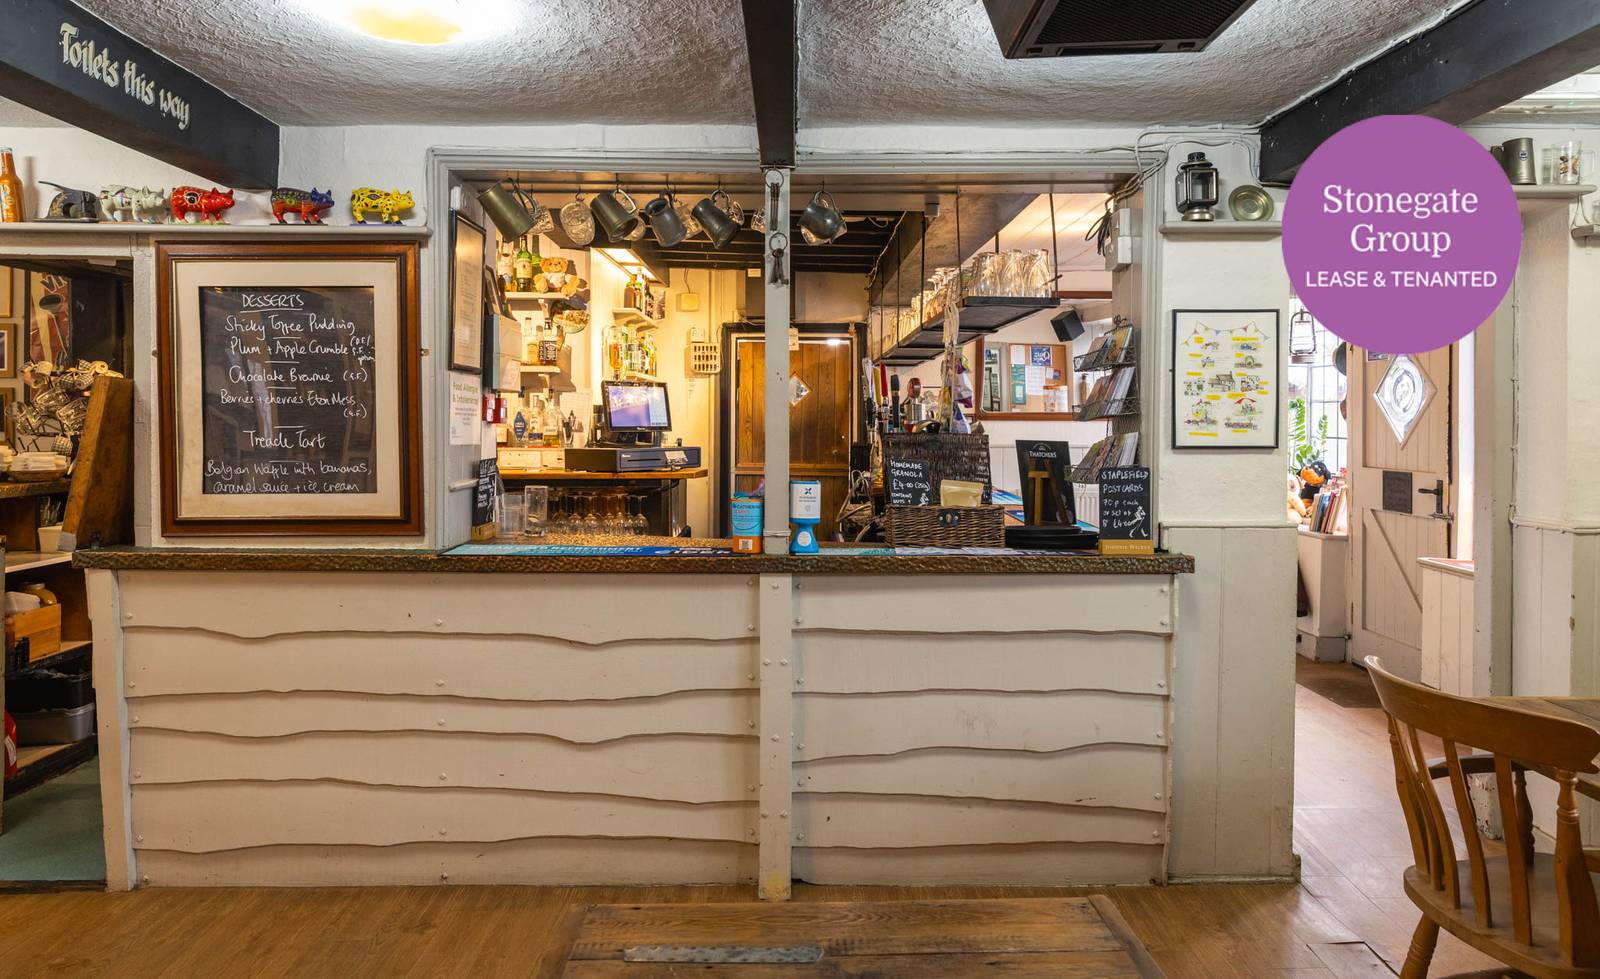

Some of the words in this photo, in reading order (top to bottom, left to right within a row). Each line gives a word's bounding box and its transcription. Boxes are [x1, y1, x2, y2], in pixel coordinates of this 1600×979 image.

[59, 22, 119, 88] Toilets
[123, 60, 155, 106] this
[159, 88, 190, 131] way
[242, 294, 305, 308] DESSERTS
[224, 315, 266, 340] Sticky
[268, 314, 304, 335] Toffee
[308, 313, 356, 336] Pudding
[230, 336, 261, 355] Plum
[268, 345, 273, 355] +
[275, 340, 307, 359] Apple
[308, 340, 349, 355] Crumble
[229, 365, 285, 384] Chocolate
[290, 368, 334, 382] Brownie
[220, 389, 255, 405] Berries
[264, 391, 304, 405] cherries
[307, 390, 331, 407] Eton
[332, 392, 356, 406] Mess
[243, 430, 294, 449] Treacle
[296, 429, 326, 449] Tart
[205, 460, 250, 480] Belgian
[254, 463, 290, 479] Waffle
[294, 463, 315, 476] with
[890, 460, 922, 470] HOMEMADE
[891, 469, 923, 478] GRANOLA
[1101, 469, 1149, 480] STAPLEFIELD
[302, 481, 321, 493] ice
[323, 482, 360, 493] cream
